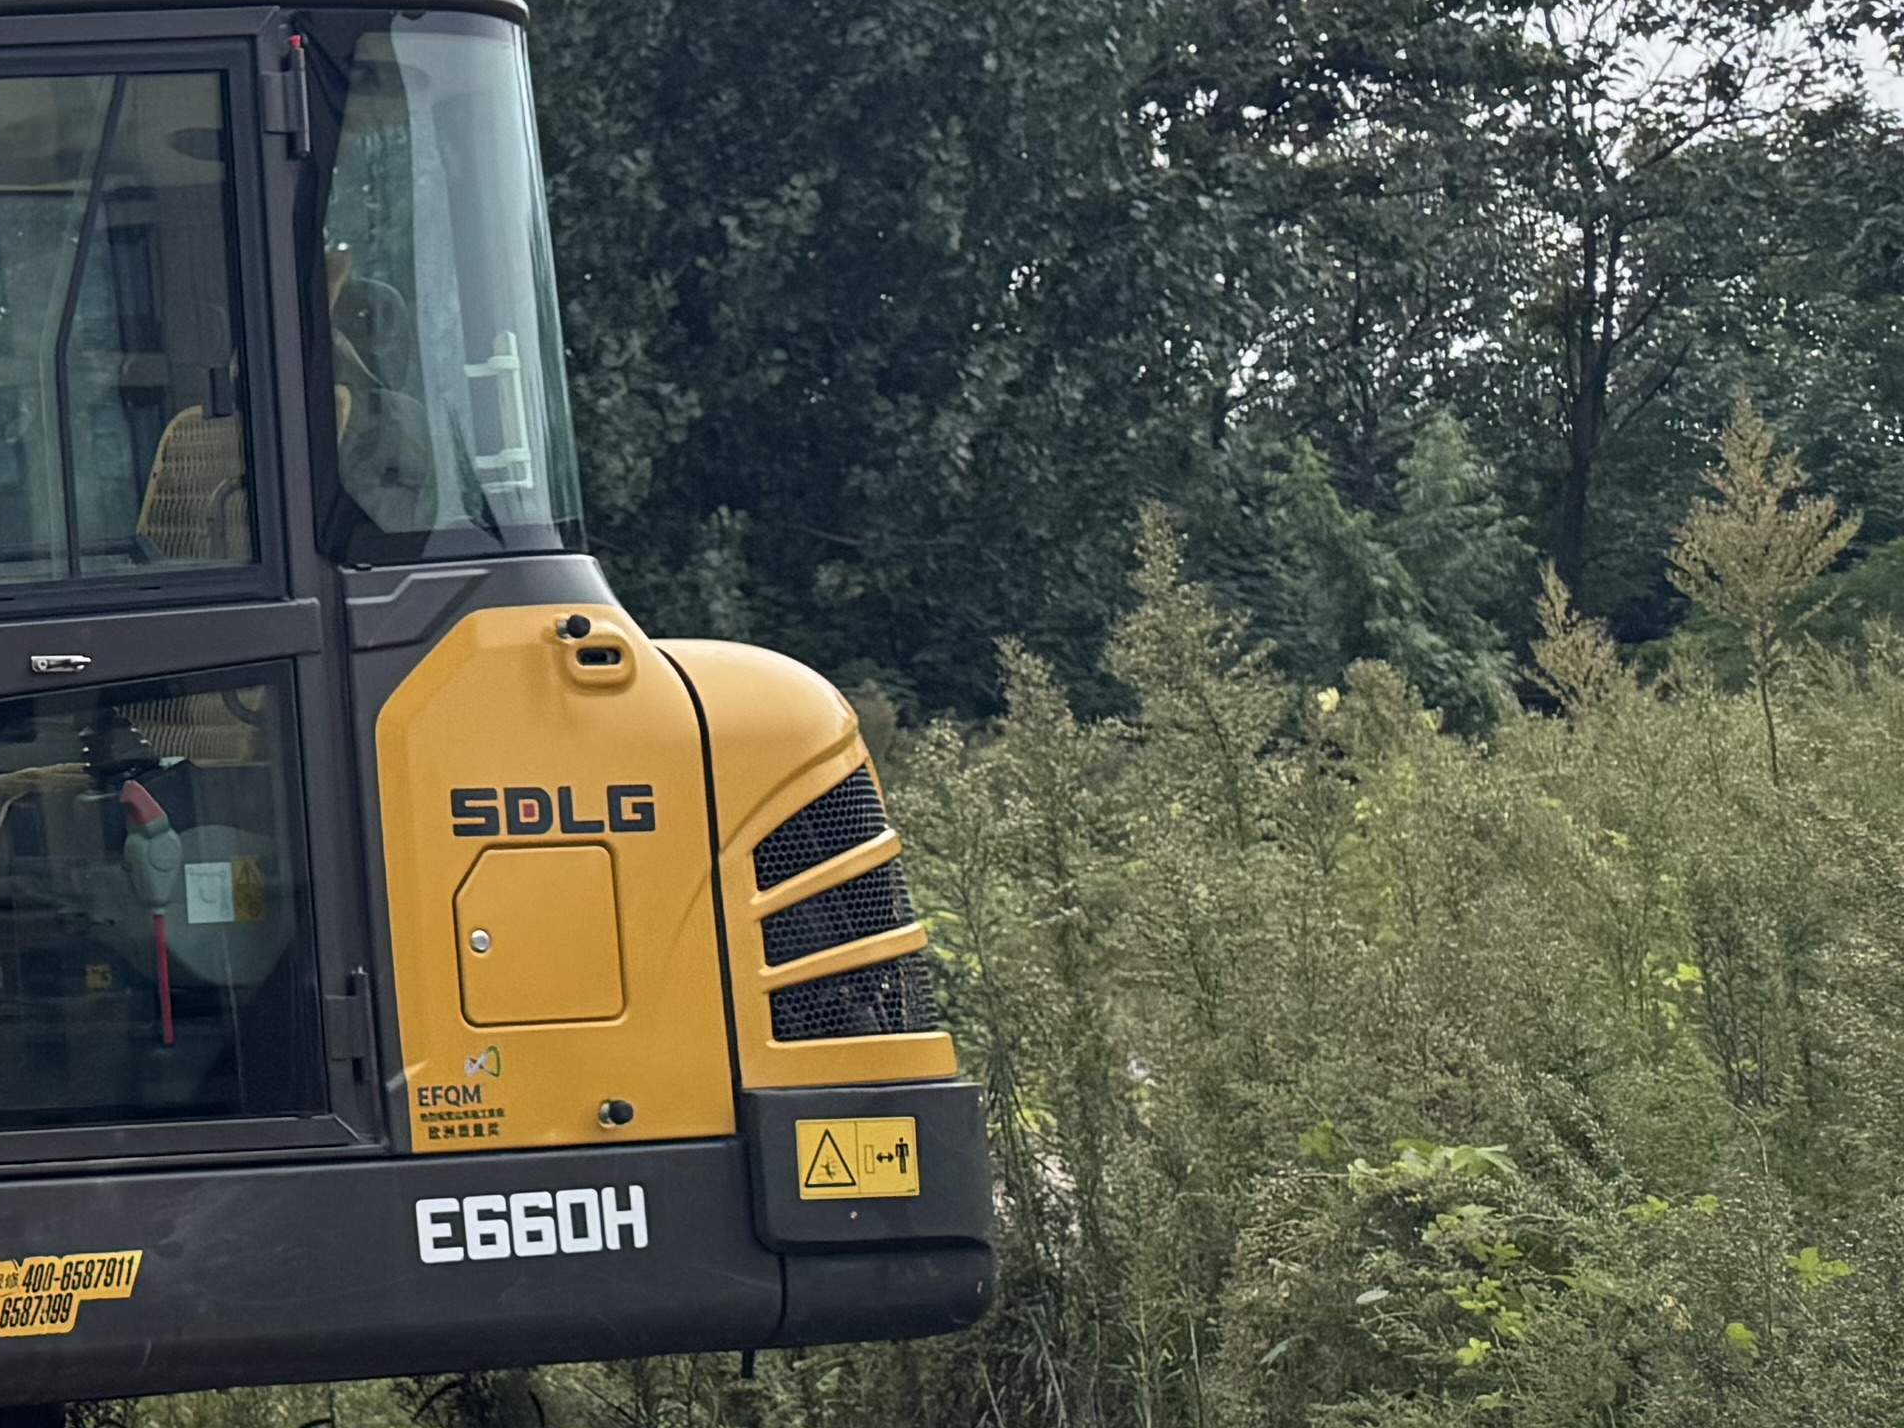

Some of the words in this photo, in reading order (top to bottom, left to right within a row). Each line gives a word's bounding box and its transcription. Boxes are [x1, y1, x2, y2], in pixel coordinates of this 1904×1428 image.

[450, 783, 656, 838] SDLG
[417, 1084, 482, 1108] EFQM
[416, 1184, 650, 1264] E660H
[21, 1255, 135, 1293] 400-6587911
